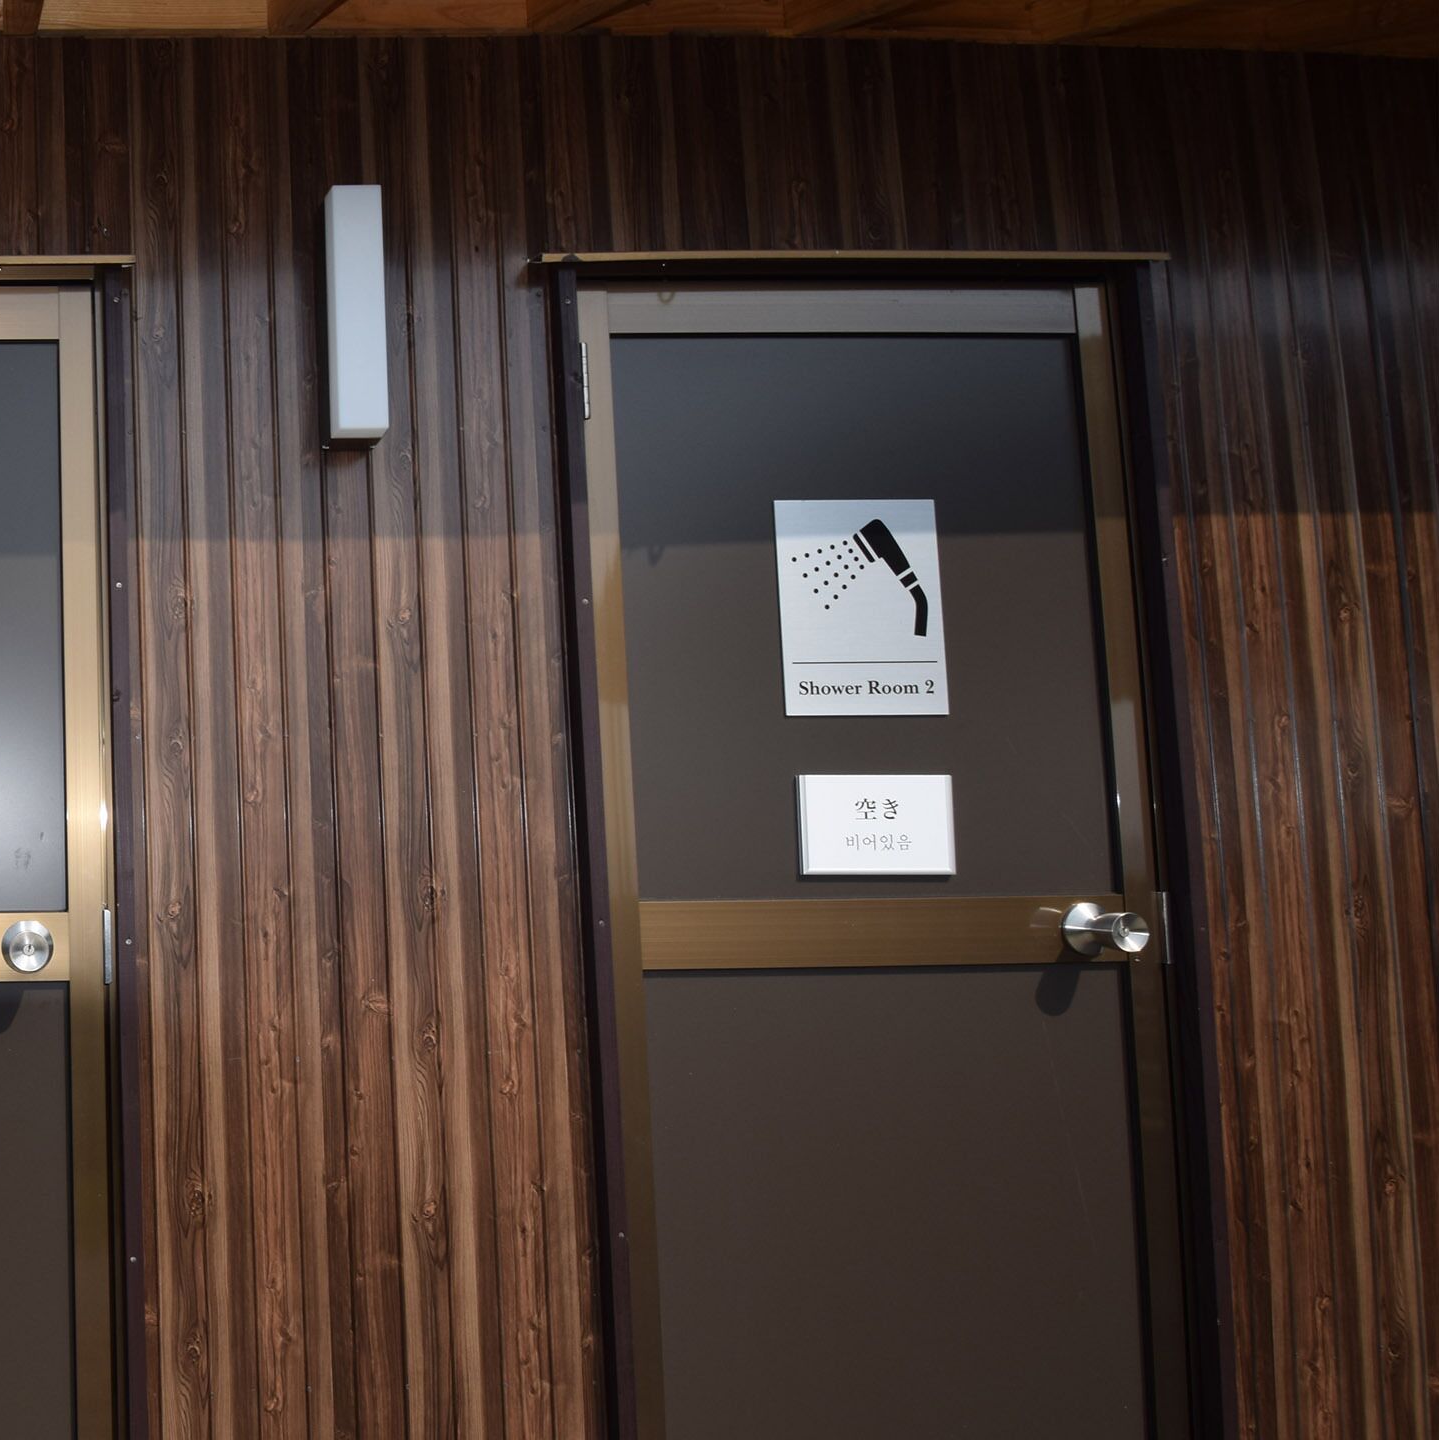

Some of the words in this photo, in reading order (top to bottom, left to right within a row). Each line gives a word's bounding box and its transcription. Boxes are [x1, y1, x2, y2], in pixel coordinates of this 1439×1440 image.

[798, 680, 863, 696] Shower
[868, 680, 919, 695] Room
[924, 679, 935, 694] 2
[855, 798, 899, 820] 空き
[845, 833, 912, 851] 비어있음
